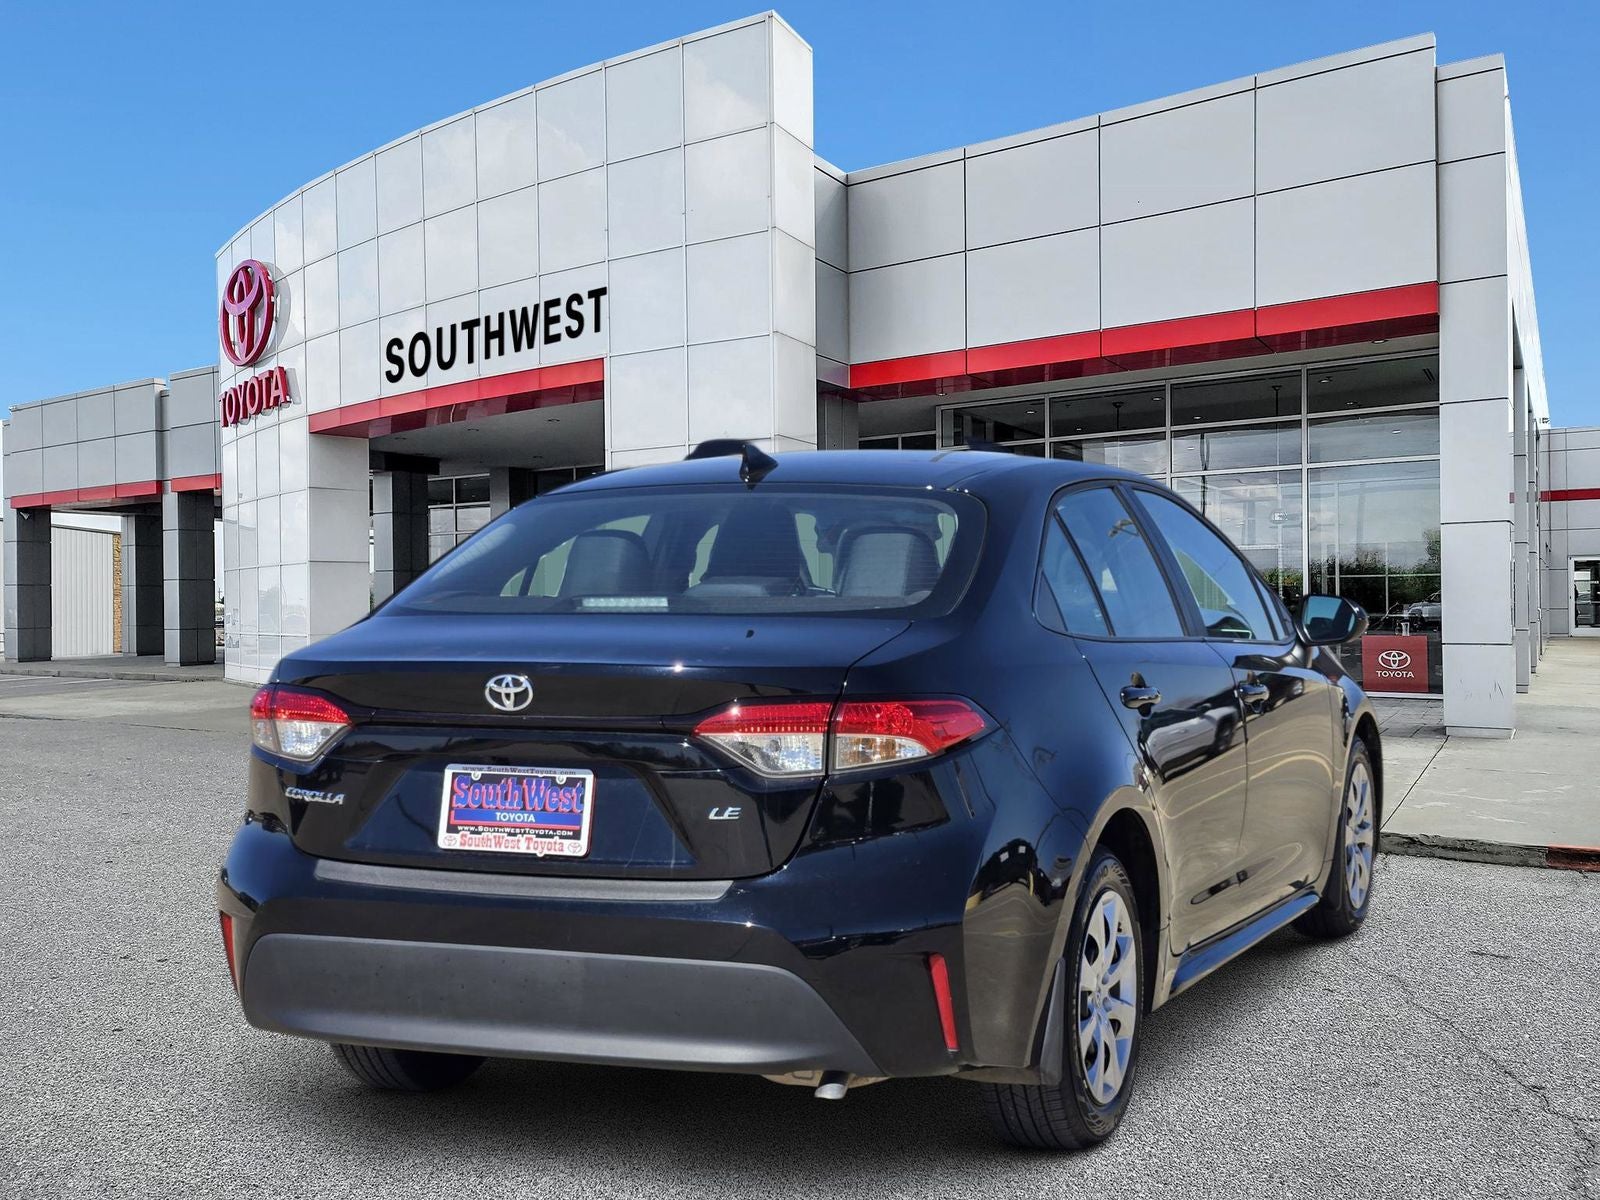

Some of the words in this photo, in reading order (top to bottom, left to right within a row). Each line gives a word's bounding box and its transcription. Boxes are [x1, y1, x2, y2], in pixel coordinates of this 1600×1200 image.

[385, 286, 607, 384] SOUTHWEST
[218, 366, 291, 427] TOYOTA
[285, 787, 345, 805] COROLLA
[452, 775, 584, 813] SouthWest
[496, 812, 536, 823] TOYOTA
[709, 807, 741, 819] LE
[459, 831, 521, 850] SouthWest
[525, 836, 564, 853] Toyota
